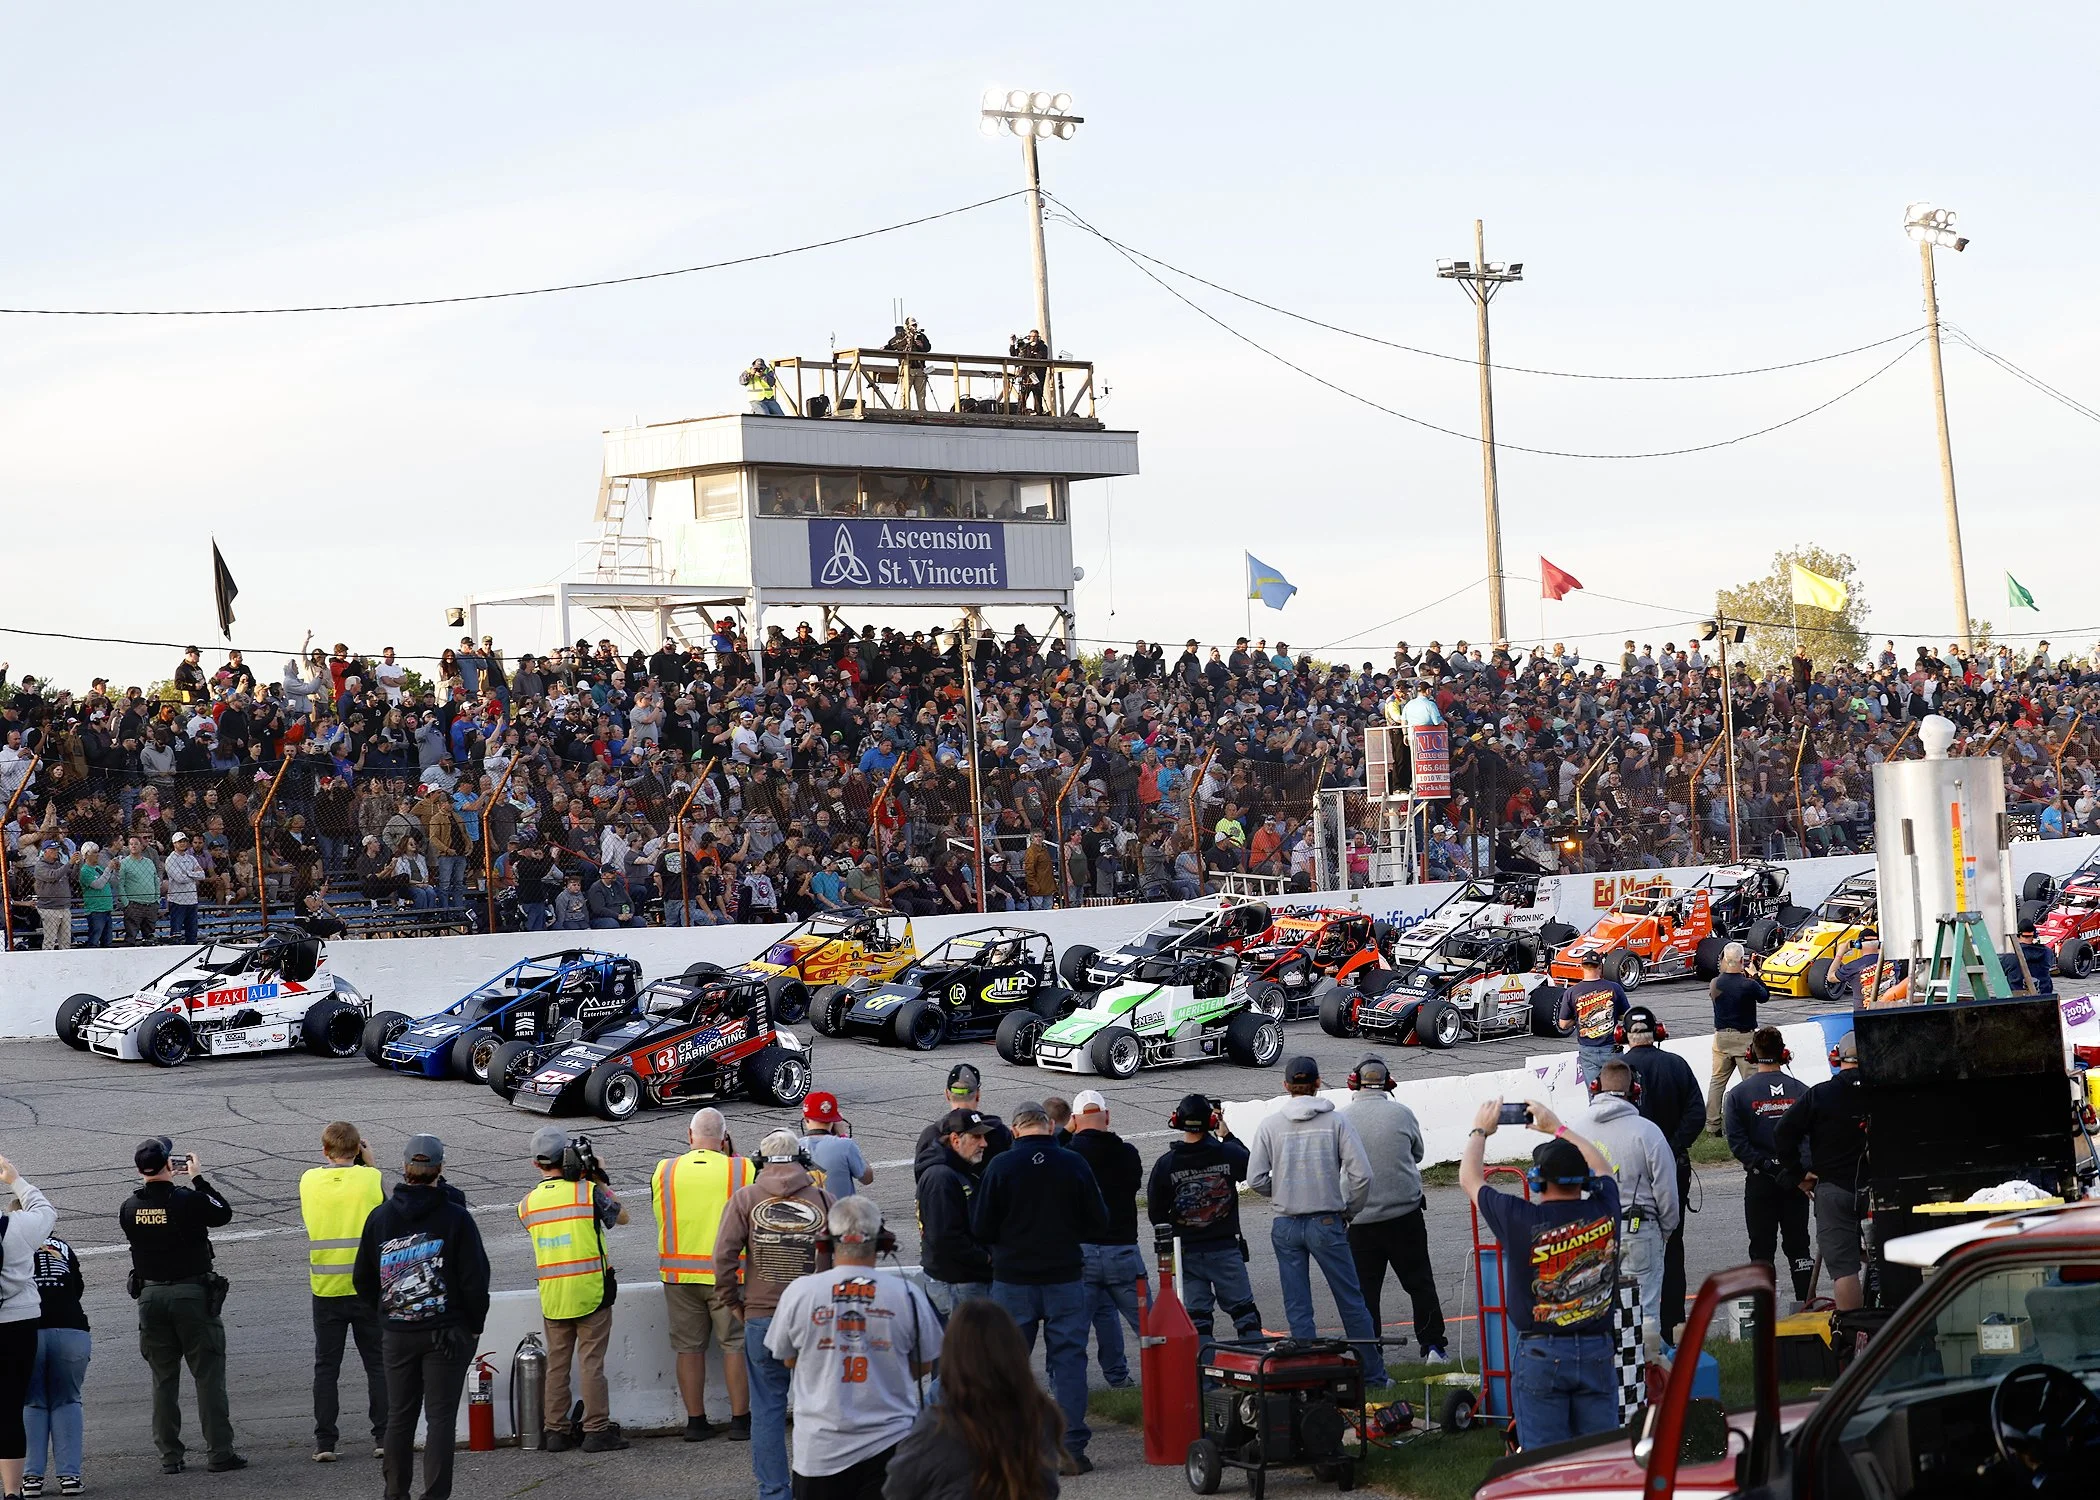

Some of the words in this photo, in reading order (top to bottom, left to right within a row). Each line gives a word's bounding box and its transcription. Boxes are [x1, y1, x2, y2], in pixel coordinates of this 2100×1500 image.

[877, 523, 993, 550] Ascension
[878, 558, 908, 585] St.
[909, 558, 999, 585] Vincent
[1594, 878, 1615, 908] Ed
[994, 976, 1029, 992] MFP
[214, 991, 246, 1004] ZAKI
[250, 989, 272, 1000] ALI
[1177, 997, 1226, 1019] MERISTEM
[677, 1038, 693, 1053] CB
[678, 1029, 747, 1064] FABRICATING
[135, 1208, 167, 1216] ALEXANDRIA
[135, 1215, 168, 1225] POLICE
[430, 1256, 444, 1268] 34
[841, 1355, 868, 1383] 18
